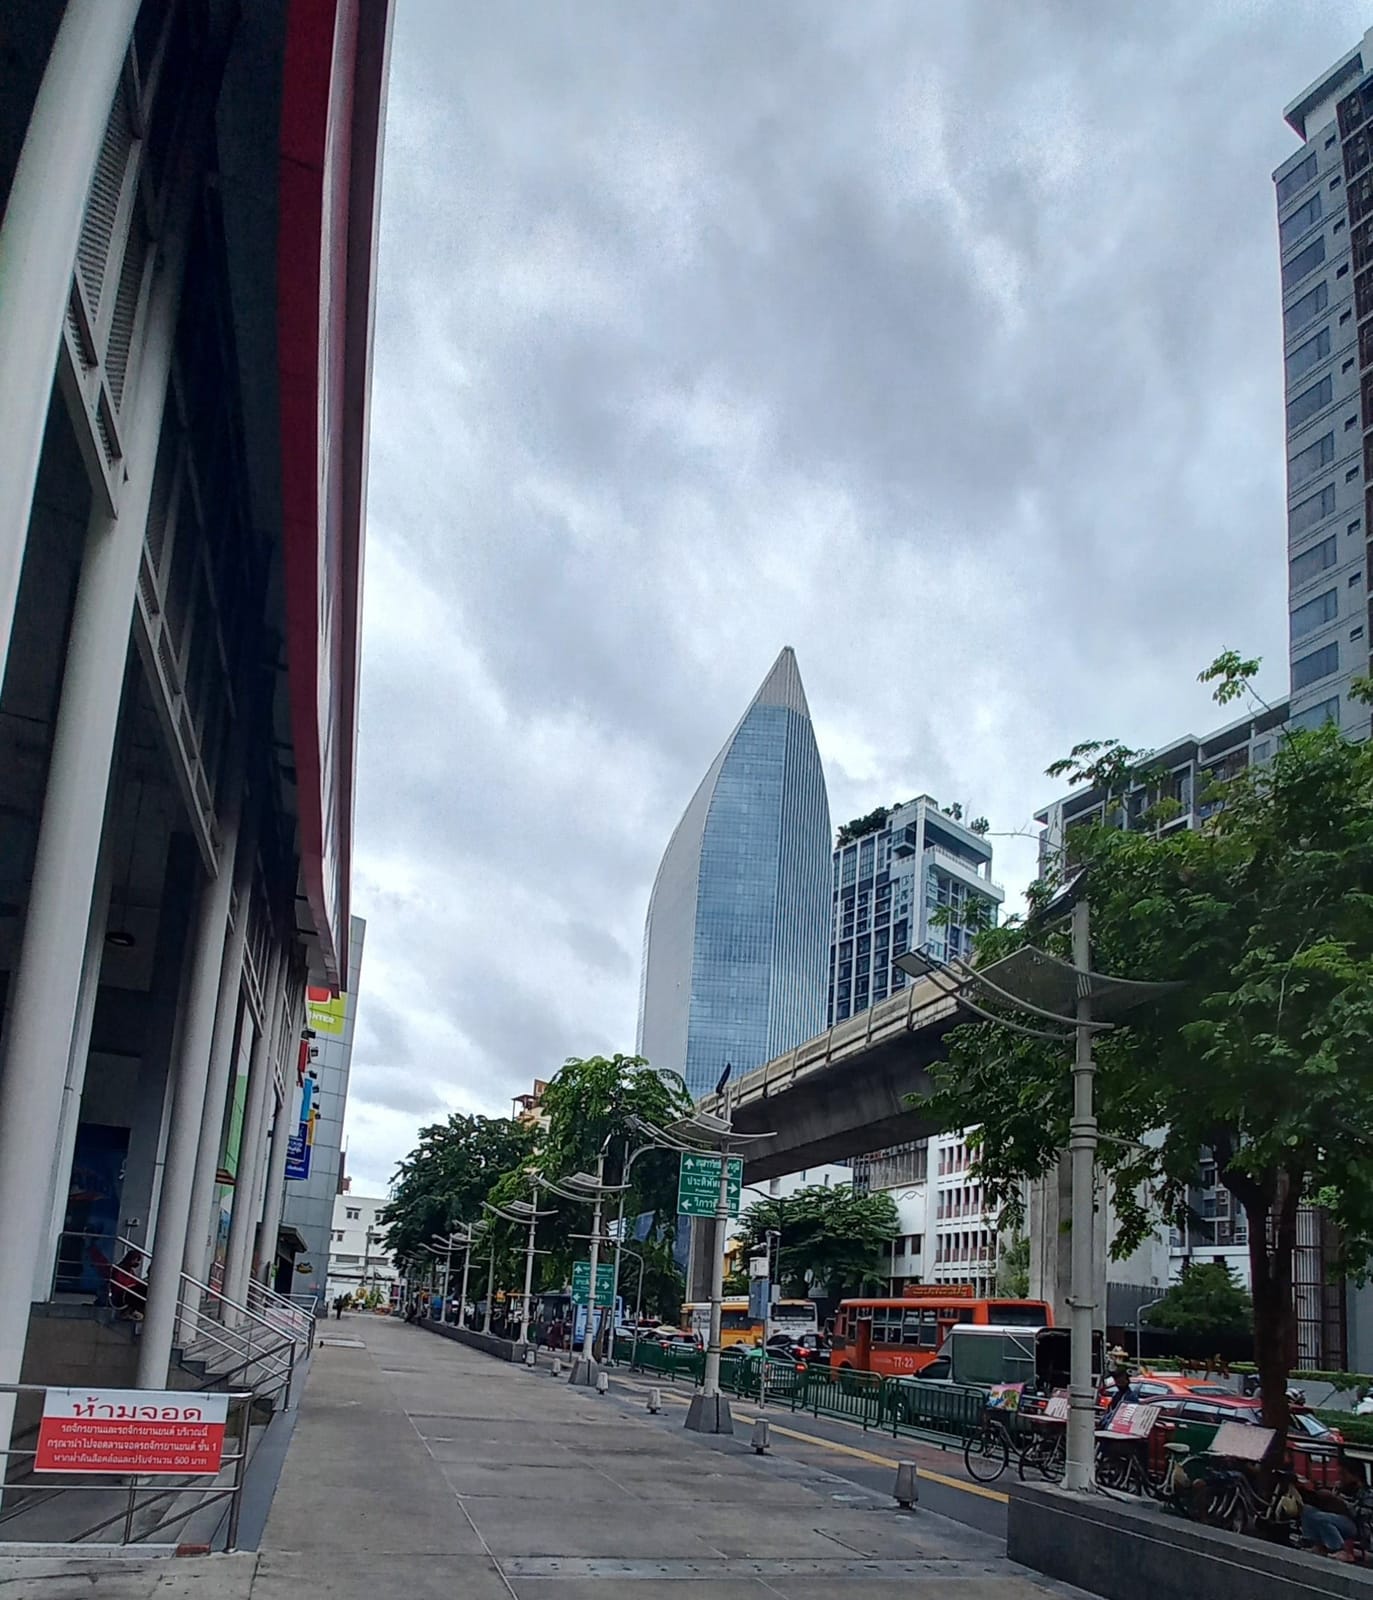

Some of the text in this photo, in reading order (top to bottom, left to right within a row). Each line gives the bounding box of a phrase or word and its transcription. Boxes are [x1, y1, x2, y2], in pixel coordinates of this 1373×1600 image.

[73, 1397, 202, 1421] ห้ามจอด
[212, 1442, 217, 1452] 1
[174, 1456, 189, 1465] 500
[191, 1457, 207, 1465] บาท
